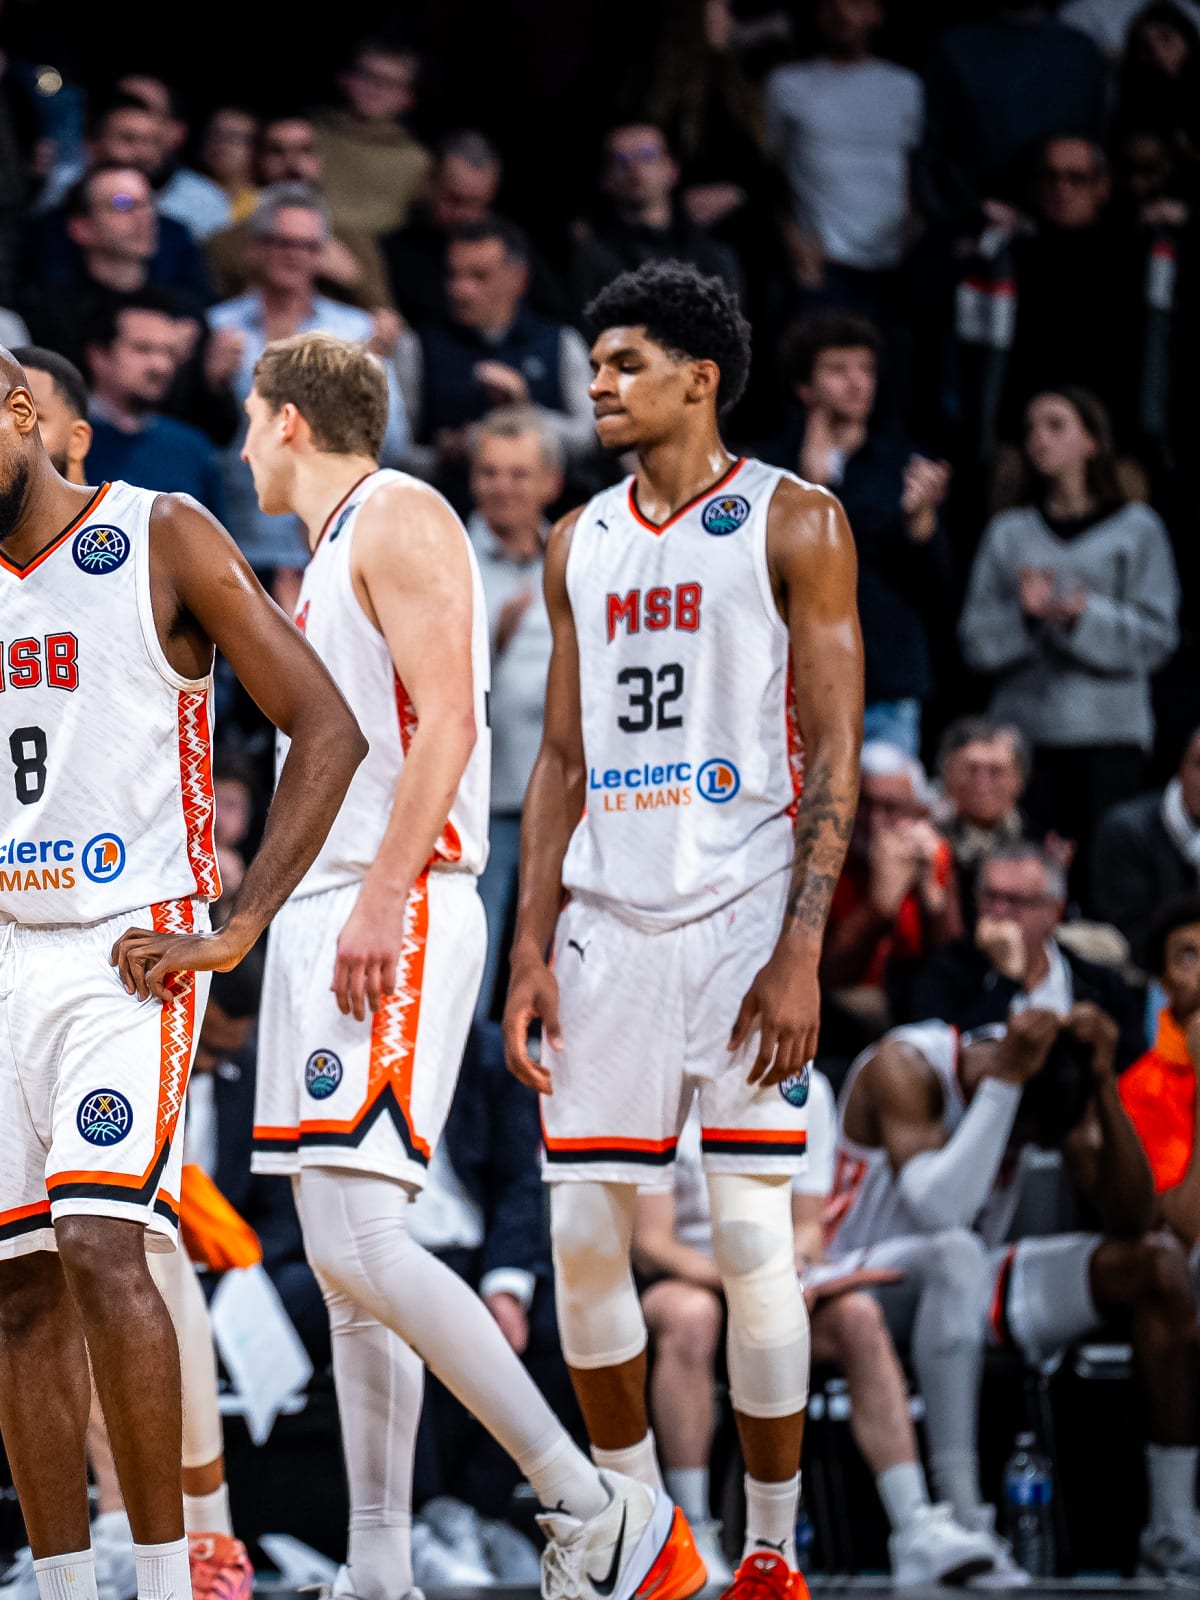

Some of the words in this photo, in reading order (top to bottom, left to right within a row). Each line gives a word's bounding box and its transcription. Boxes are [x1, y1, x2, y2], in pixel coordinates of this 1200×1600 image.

[606, 582, 701, 643] MSB
[617, 663, 684, 733] 32
[9, 725, 47, 805] 8
[604, 793, 627, 812] LE
[636, 787, 692, 811] MANS
[0, 867, 75, 892] MANS
